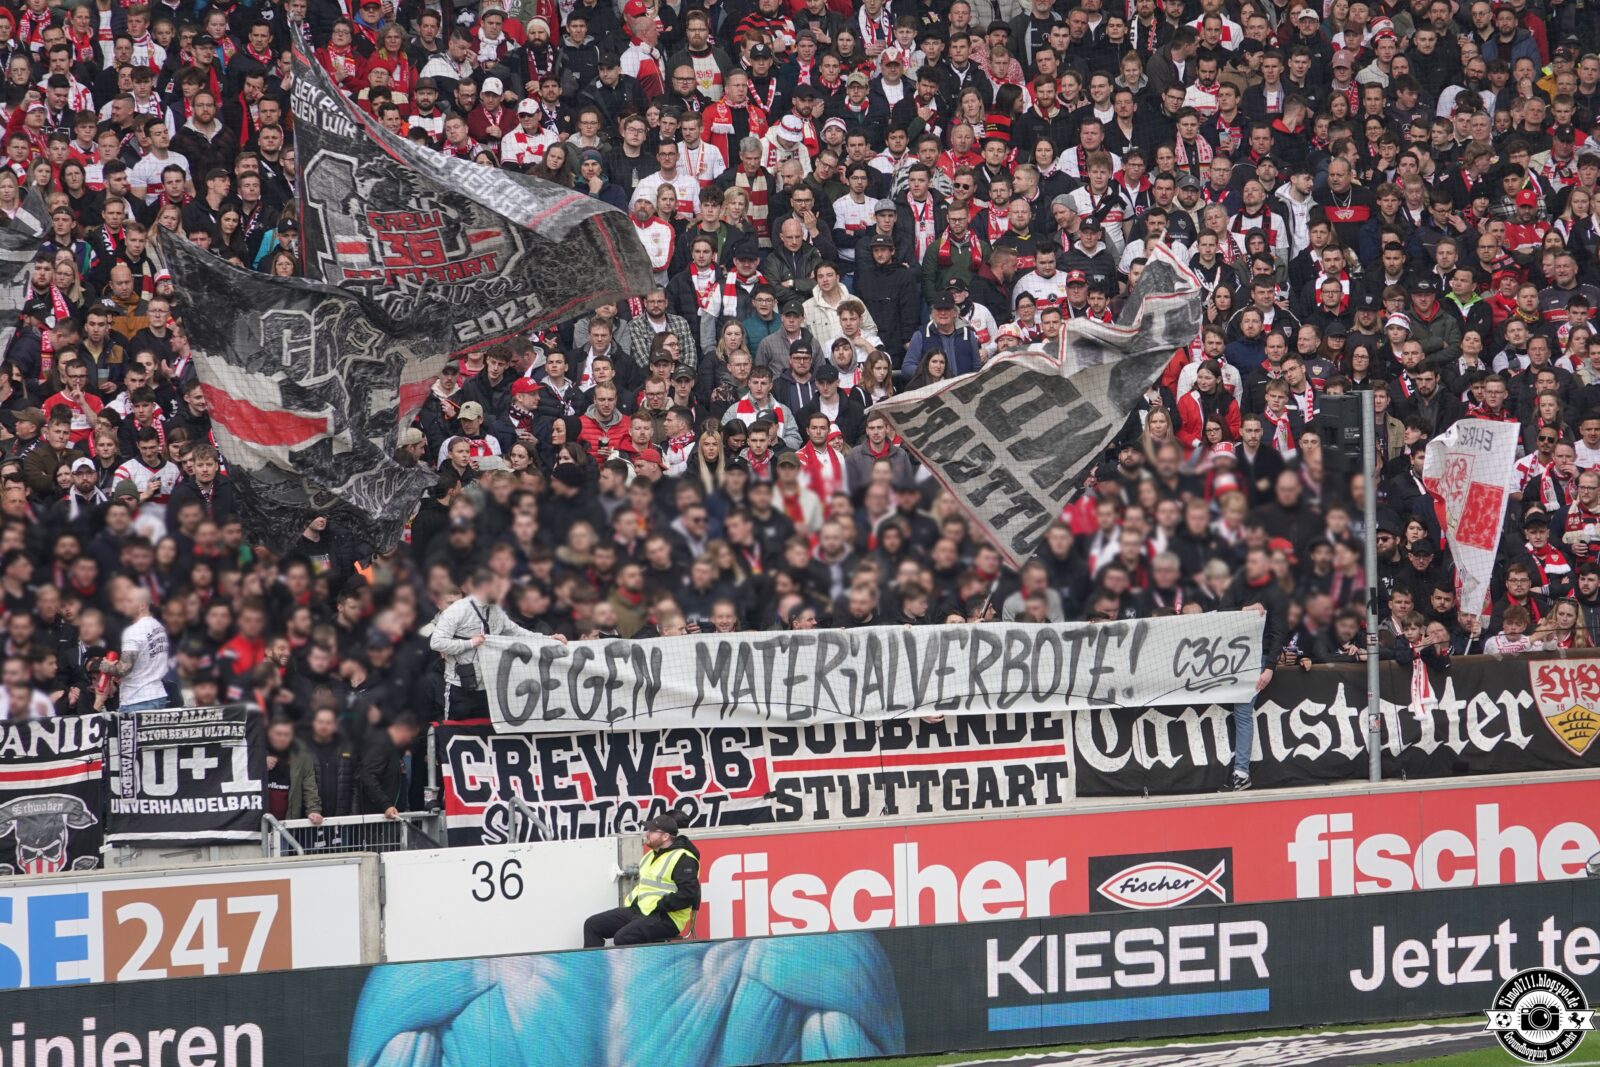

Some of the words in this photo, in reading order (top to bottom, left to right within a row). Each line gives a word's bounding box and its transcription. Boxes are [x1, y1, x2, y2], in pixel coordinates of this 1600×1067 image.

[366, 210, 445, 232] CREW
[378, 229, 448, 267] 36
[453, 293, 544, 342] 2023
[496, 639, 663, 727] GEGEN
[692, 620, 1150, 721] MATERIALVERBOTE!
[0, 715, 104, 759] ANIE
[141, 712, 180, 726] EHRE
[181, 708, 224, 722] ALLEN
[205, 725, 246, 737] ULTRAS
[1076, 676, 1535, 773] Cannstatter
[446, 729, 663, 807] CREW
[660, 727, 756, 797] 36
[11, 800, 64, 817] Schwaben
[110, 795, 264, 815] UNVERHANDELBAR
[775, 761, 1069, 823] STUTTGART
[471, 858, 525, 903] 36
[700, 842, 1067, 940] fischer
[1119, 876, 1195, 895] fischer
[115, 894, 279, 983] 247
[986, 920, 1270, 998] KIESER
[1350, 918, 1518, 992] Jetzt
